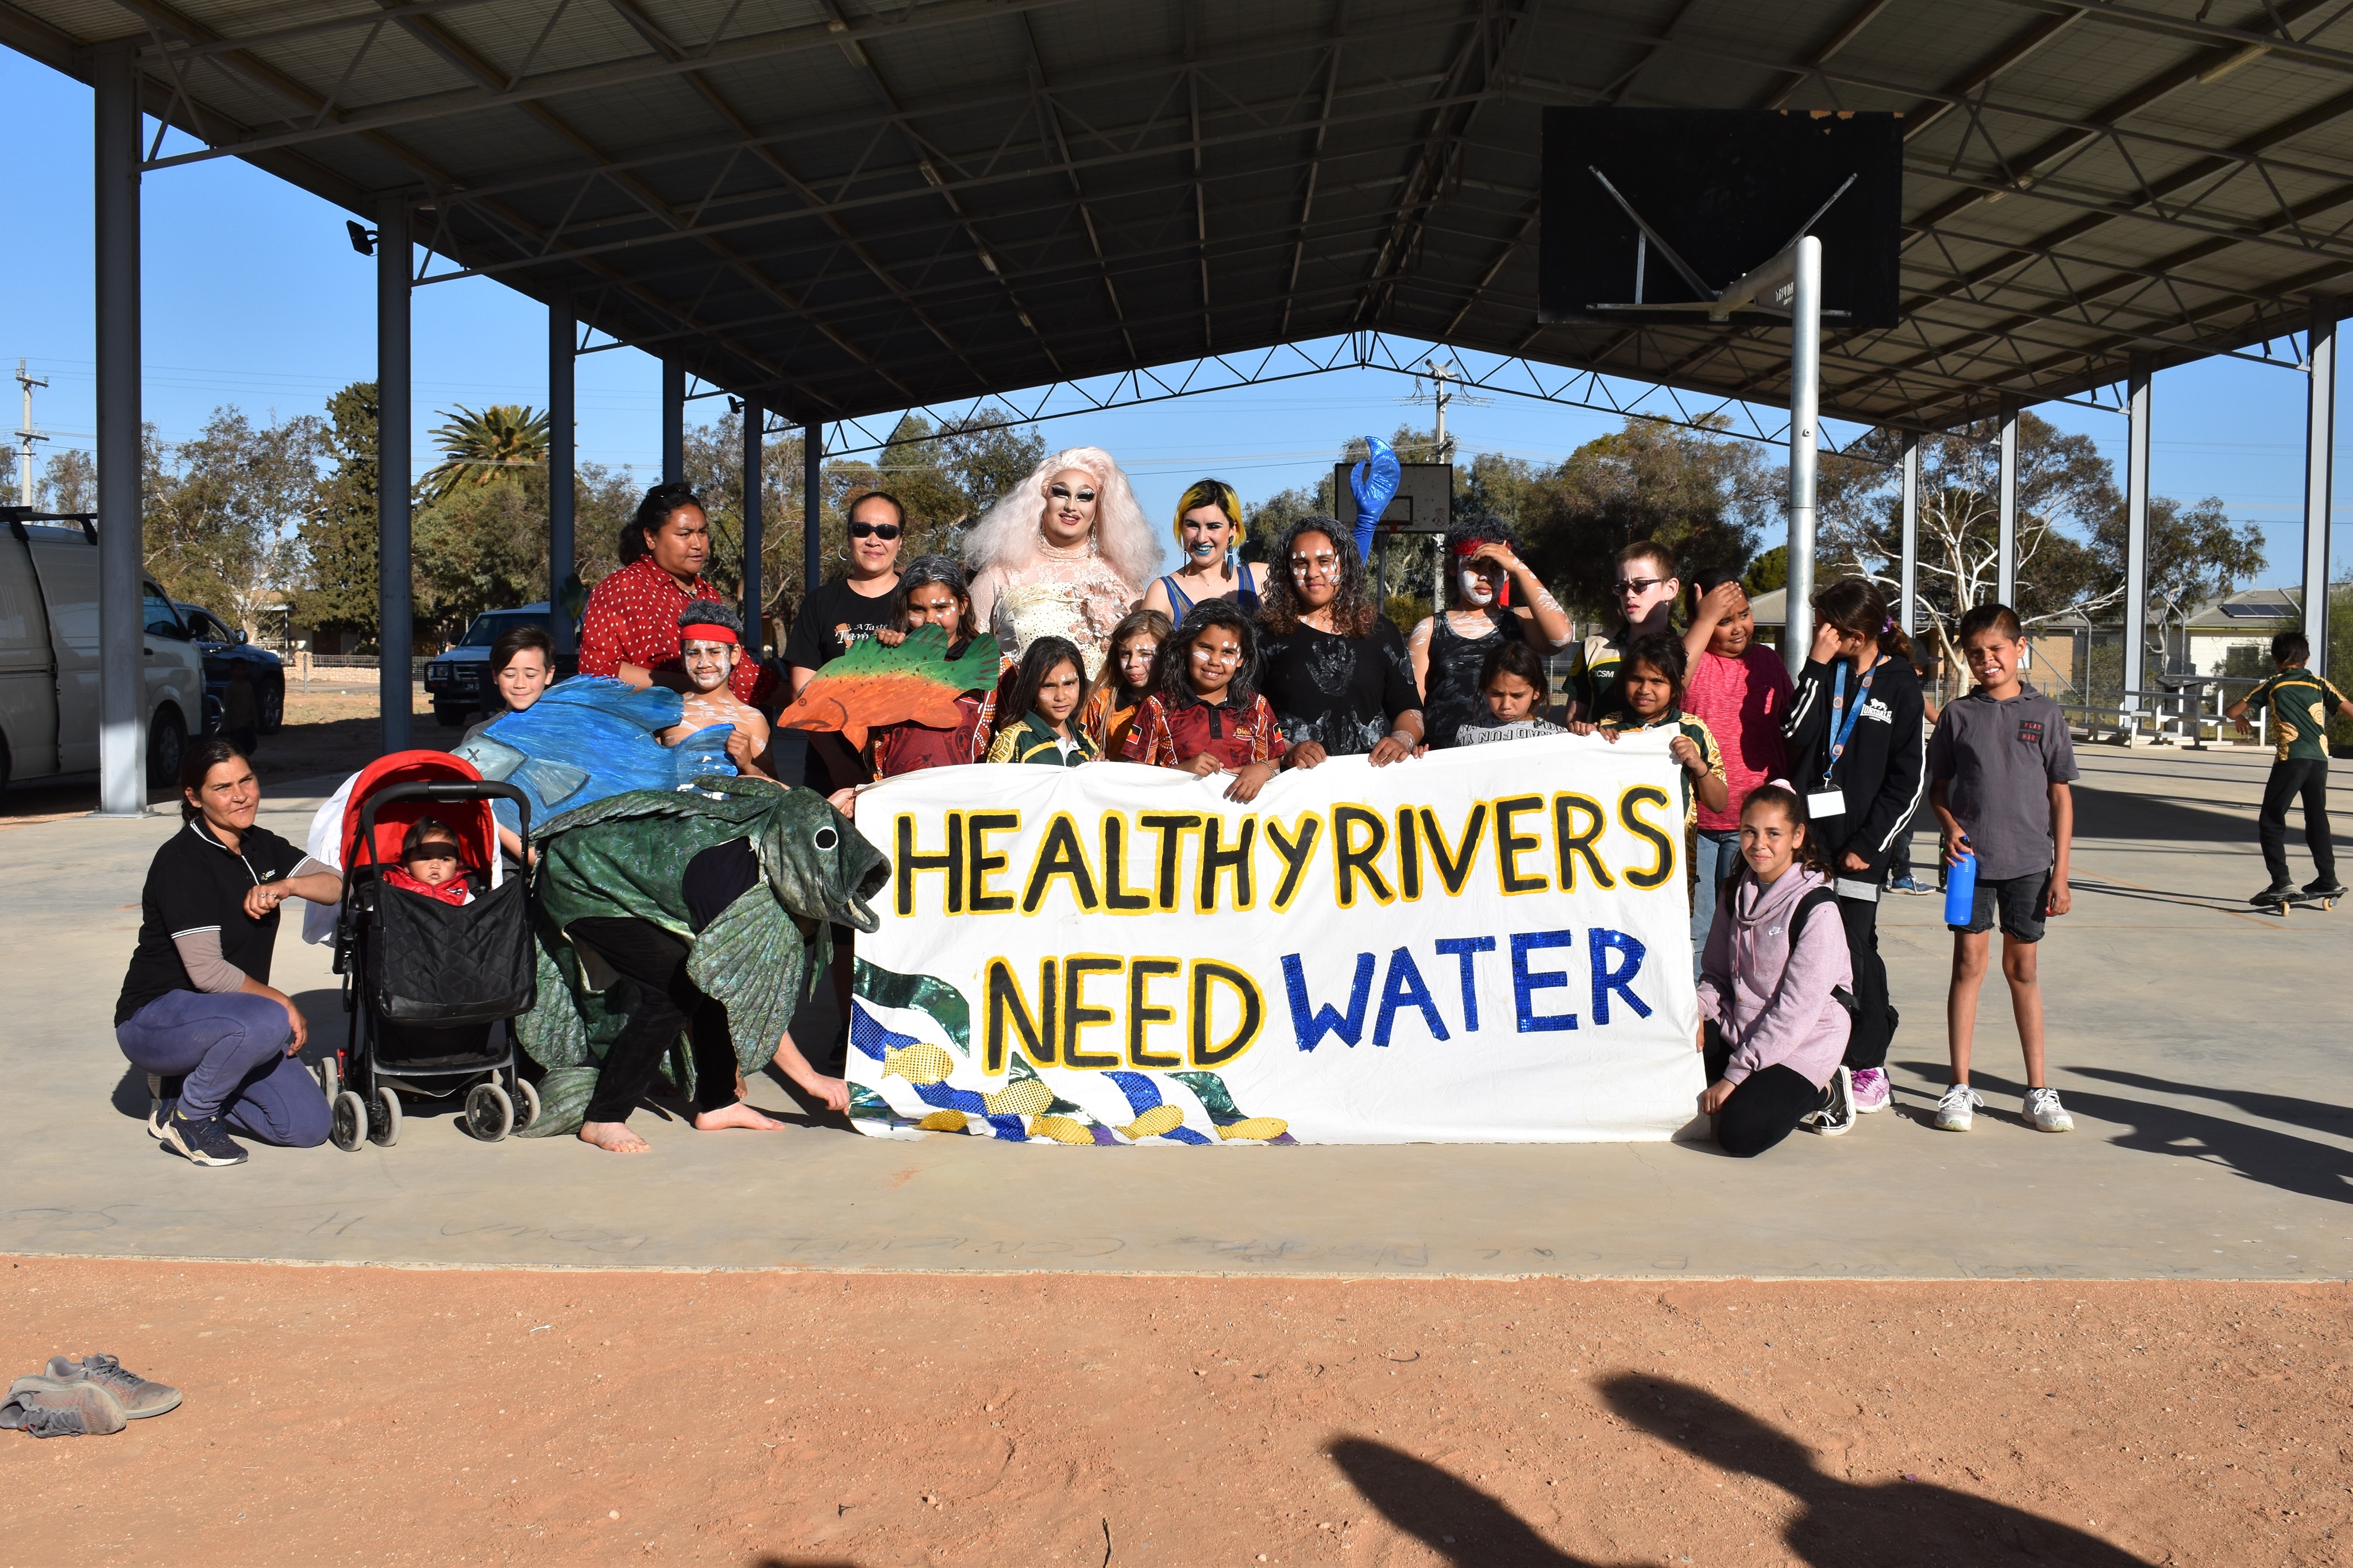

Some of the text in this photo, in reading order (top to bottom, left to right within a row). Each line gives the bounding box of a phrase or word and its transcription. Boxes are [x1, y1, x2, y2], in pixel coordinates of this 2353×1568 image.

[1860, 703, 1892, 724] LONSDALE
[2024, 722, 2042, 730] PLAY
[1478, 729, 1513, 743] FUN
[982, 927, 1652, 1076] NEED WATER
